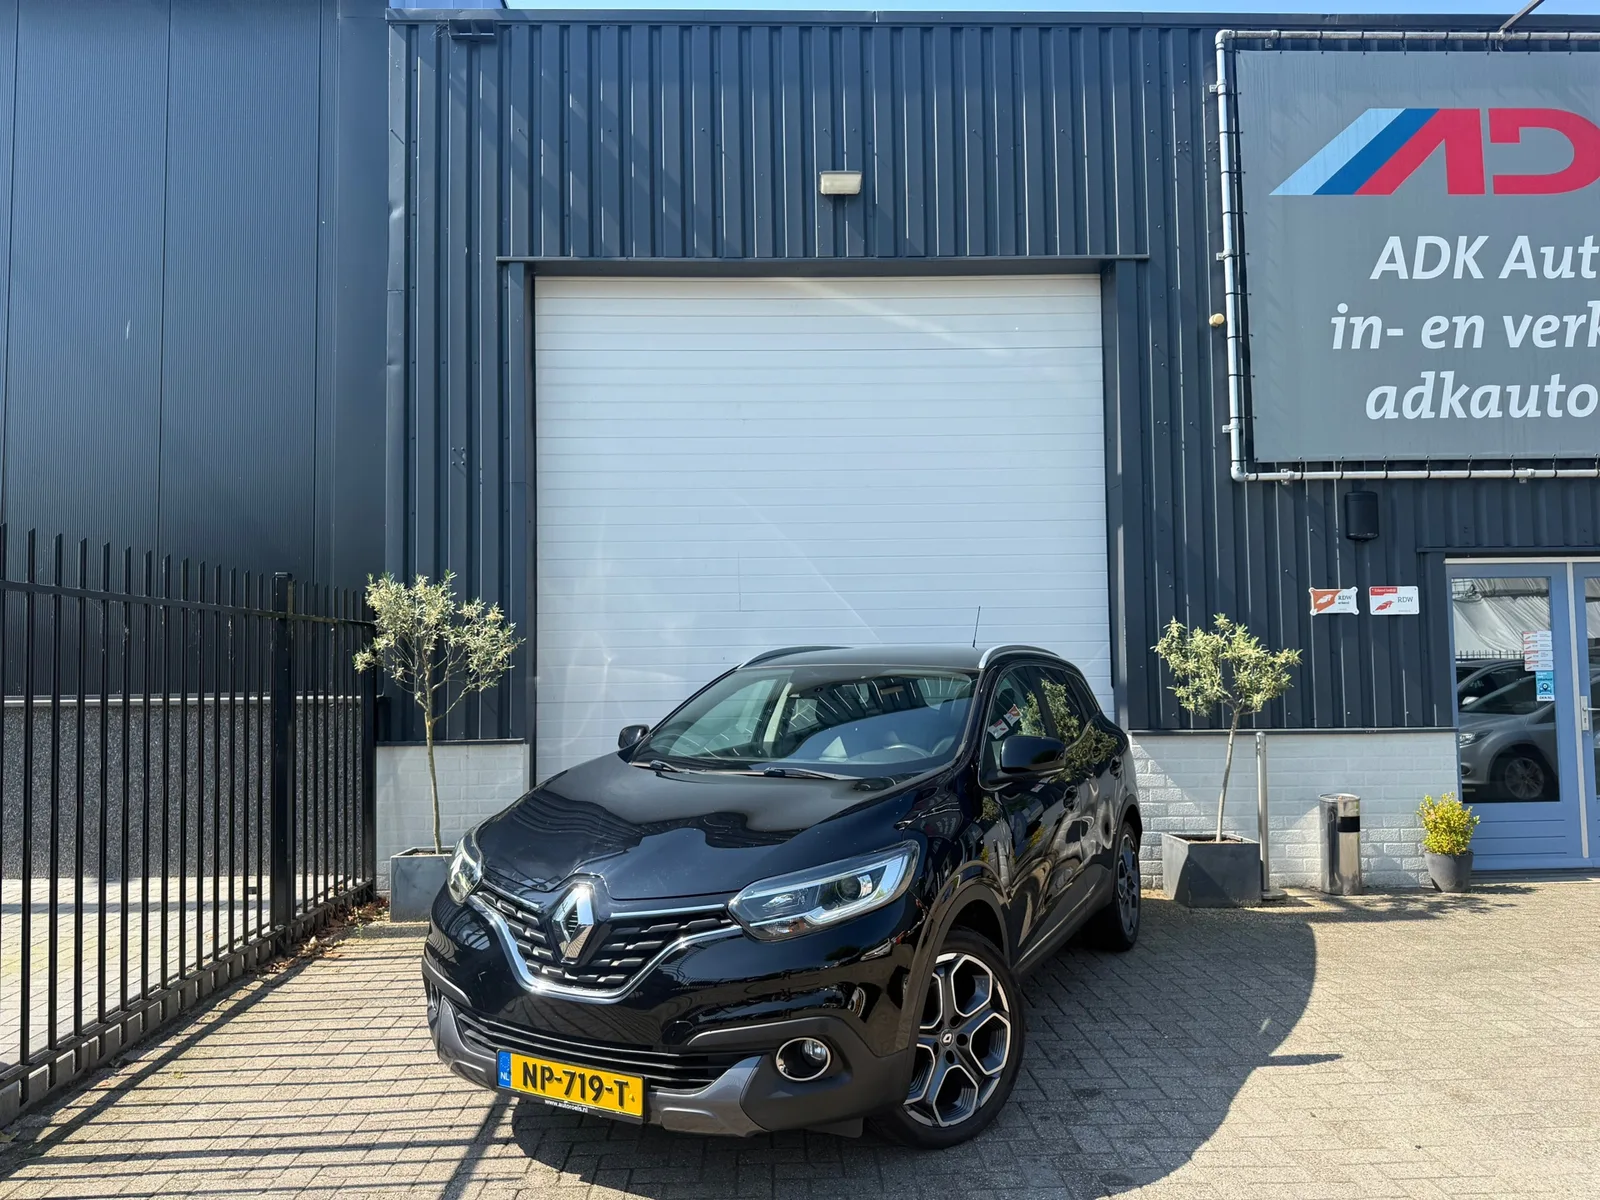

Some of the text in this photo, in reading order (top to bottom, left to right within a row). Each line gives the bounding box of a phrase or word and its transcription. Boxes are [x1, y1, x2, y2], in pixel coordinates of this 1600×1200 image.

[1369, 235, 1600, 280] ADK Aut
[1330, 302, 1404, 350] in-
[1420, 314, 1485, 349] en
[1365, 371, 1599, 420] adkauto
[500, 1061, 629, 1108] NL NP-719-T
